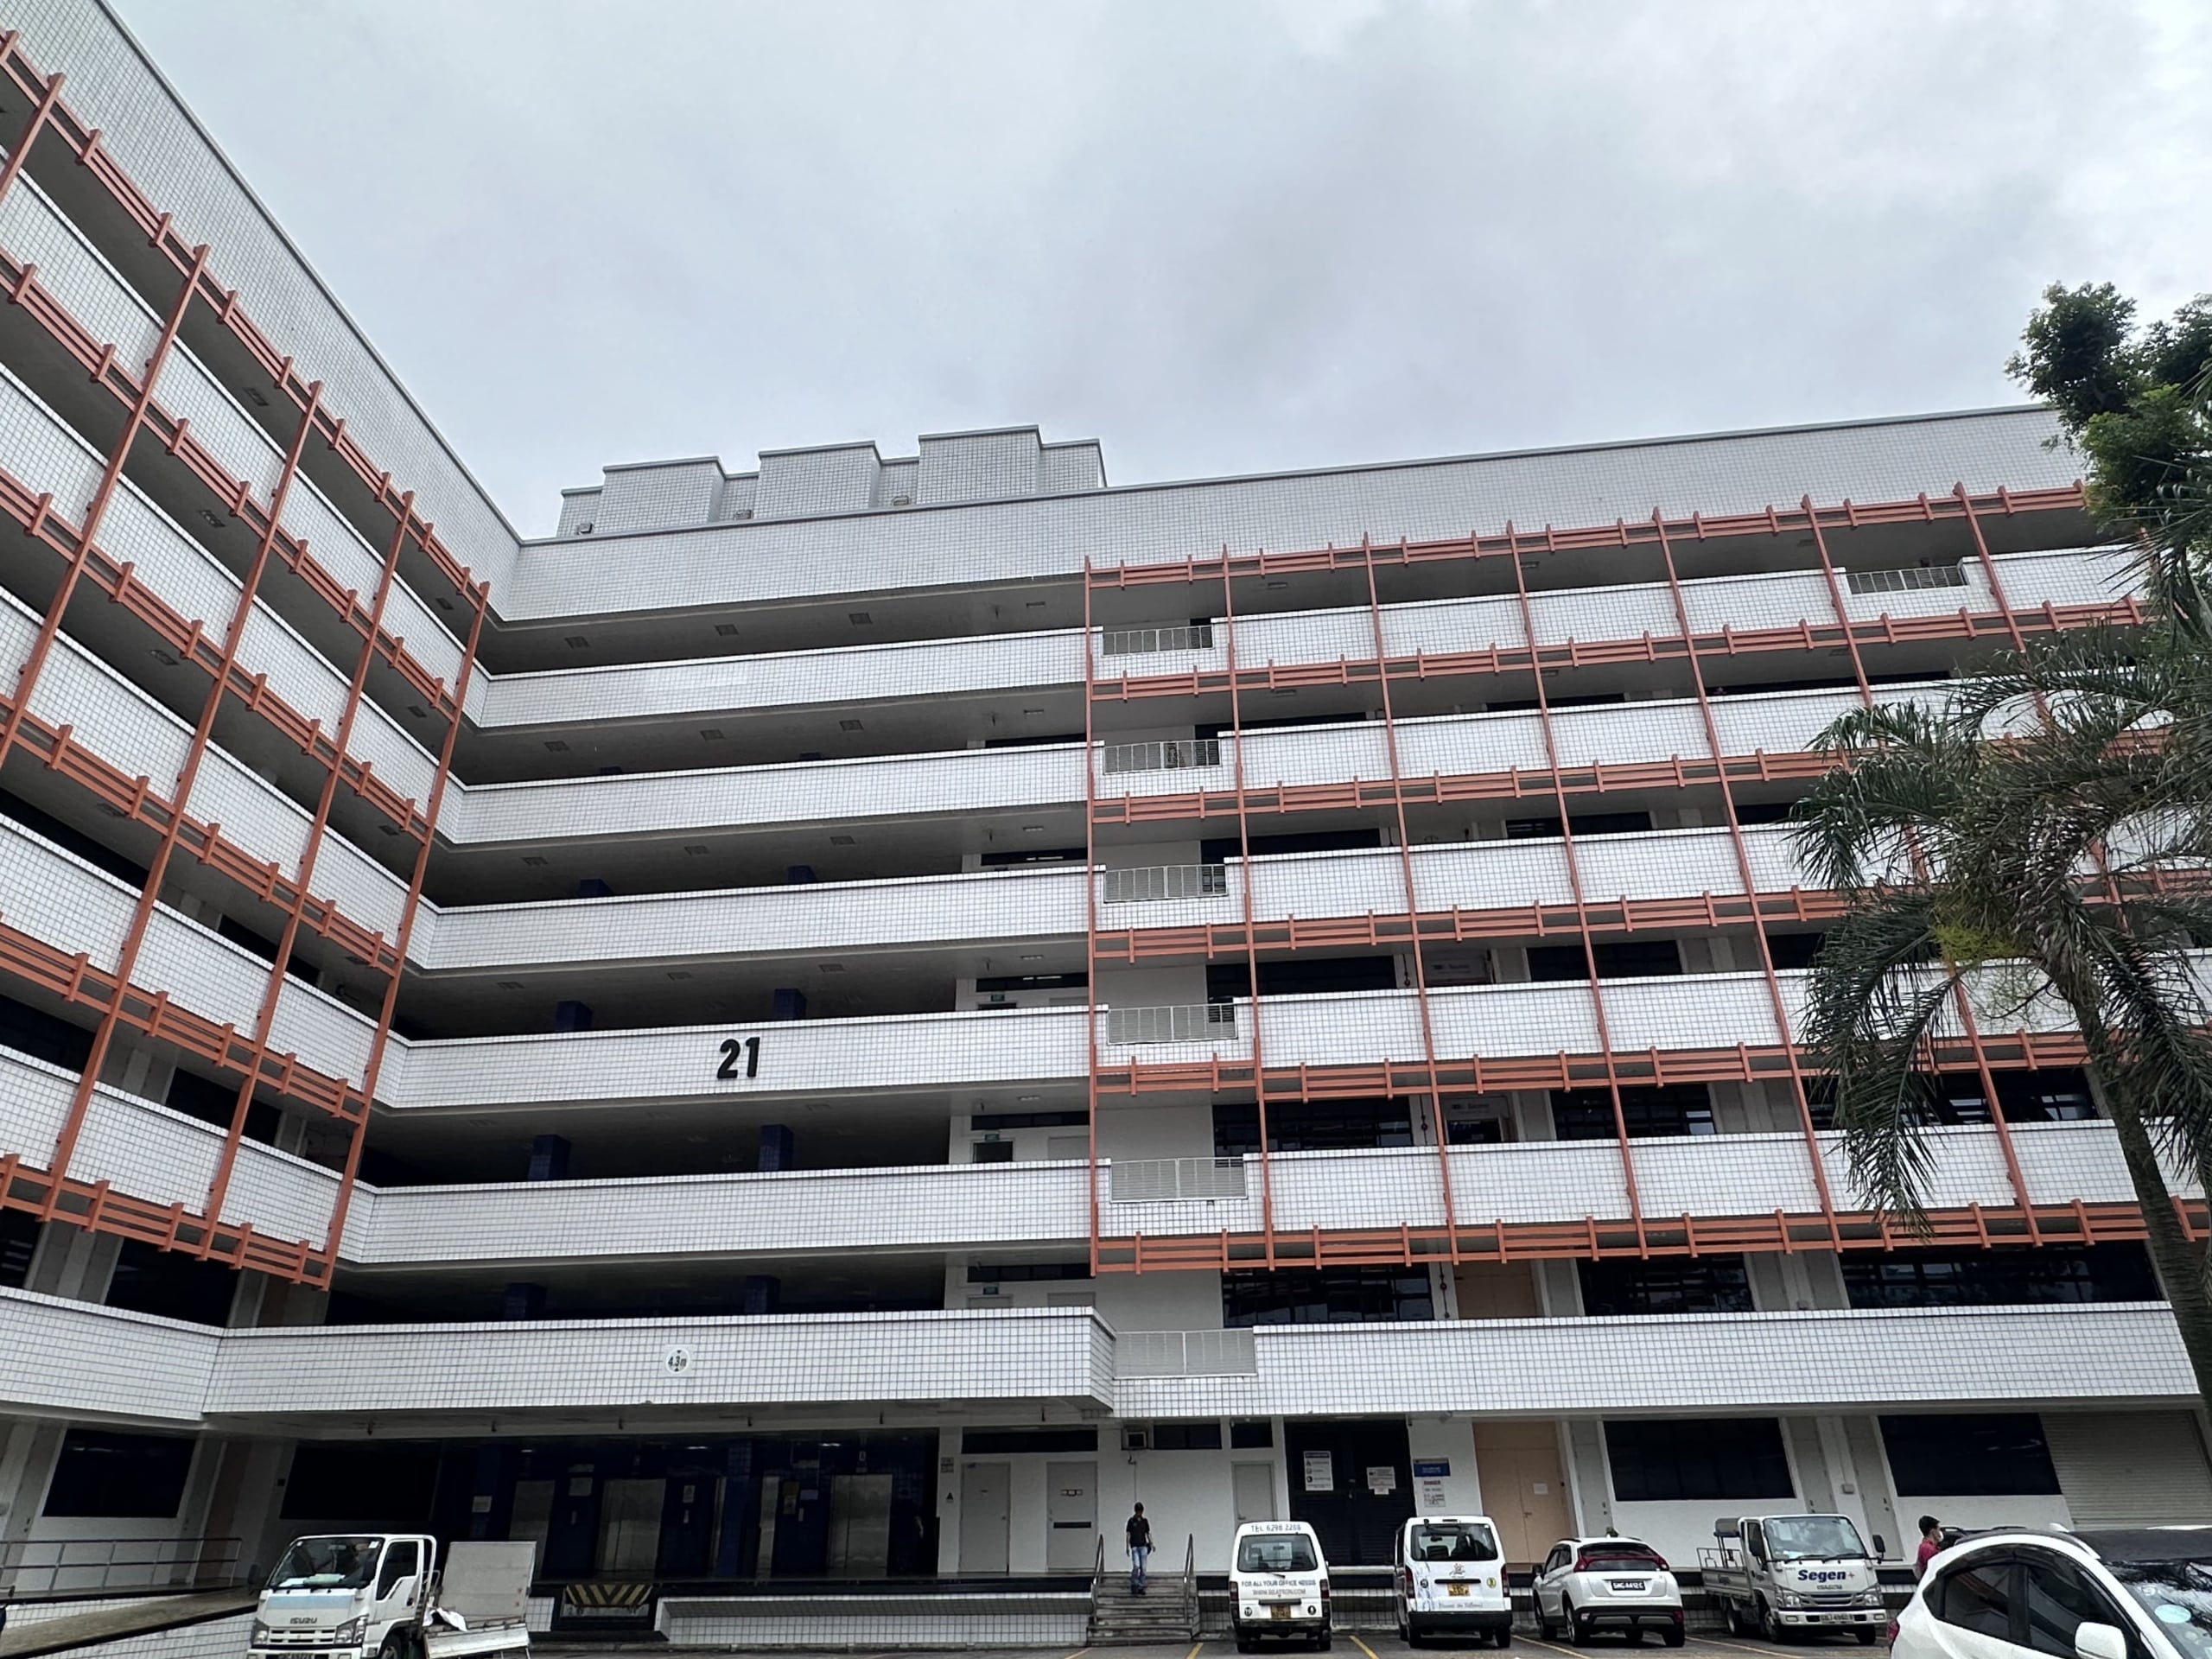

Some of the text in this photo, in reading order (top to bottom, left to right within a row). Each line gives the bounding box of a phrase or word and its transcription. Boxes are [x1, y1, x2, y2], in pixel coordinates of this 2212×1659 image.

[716, 1036, 760, 1079] 21
[1250, 1524, 1264, 1533] TEL
[1797, 1569, 1847, 1583] Segen
